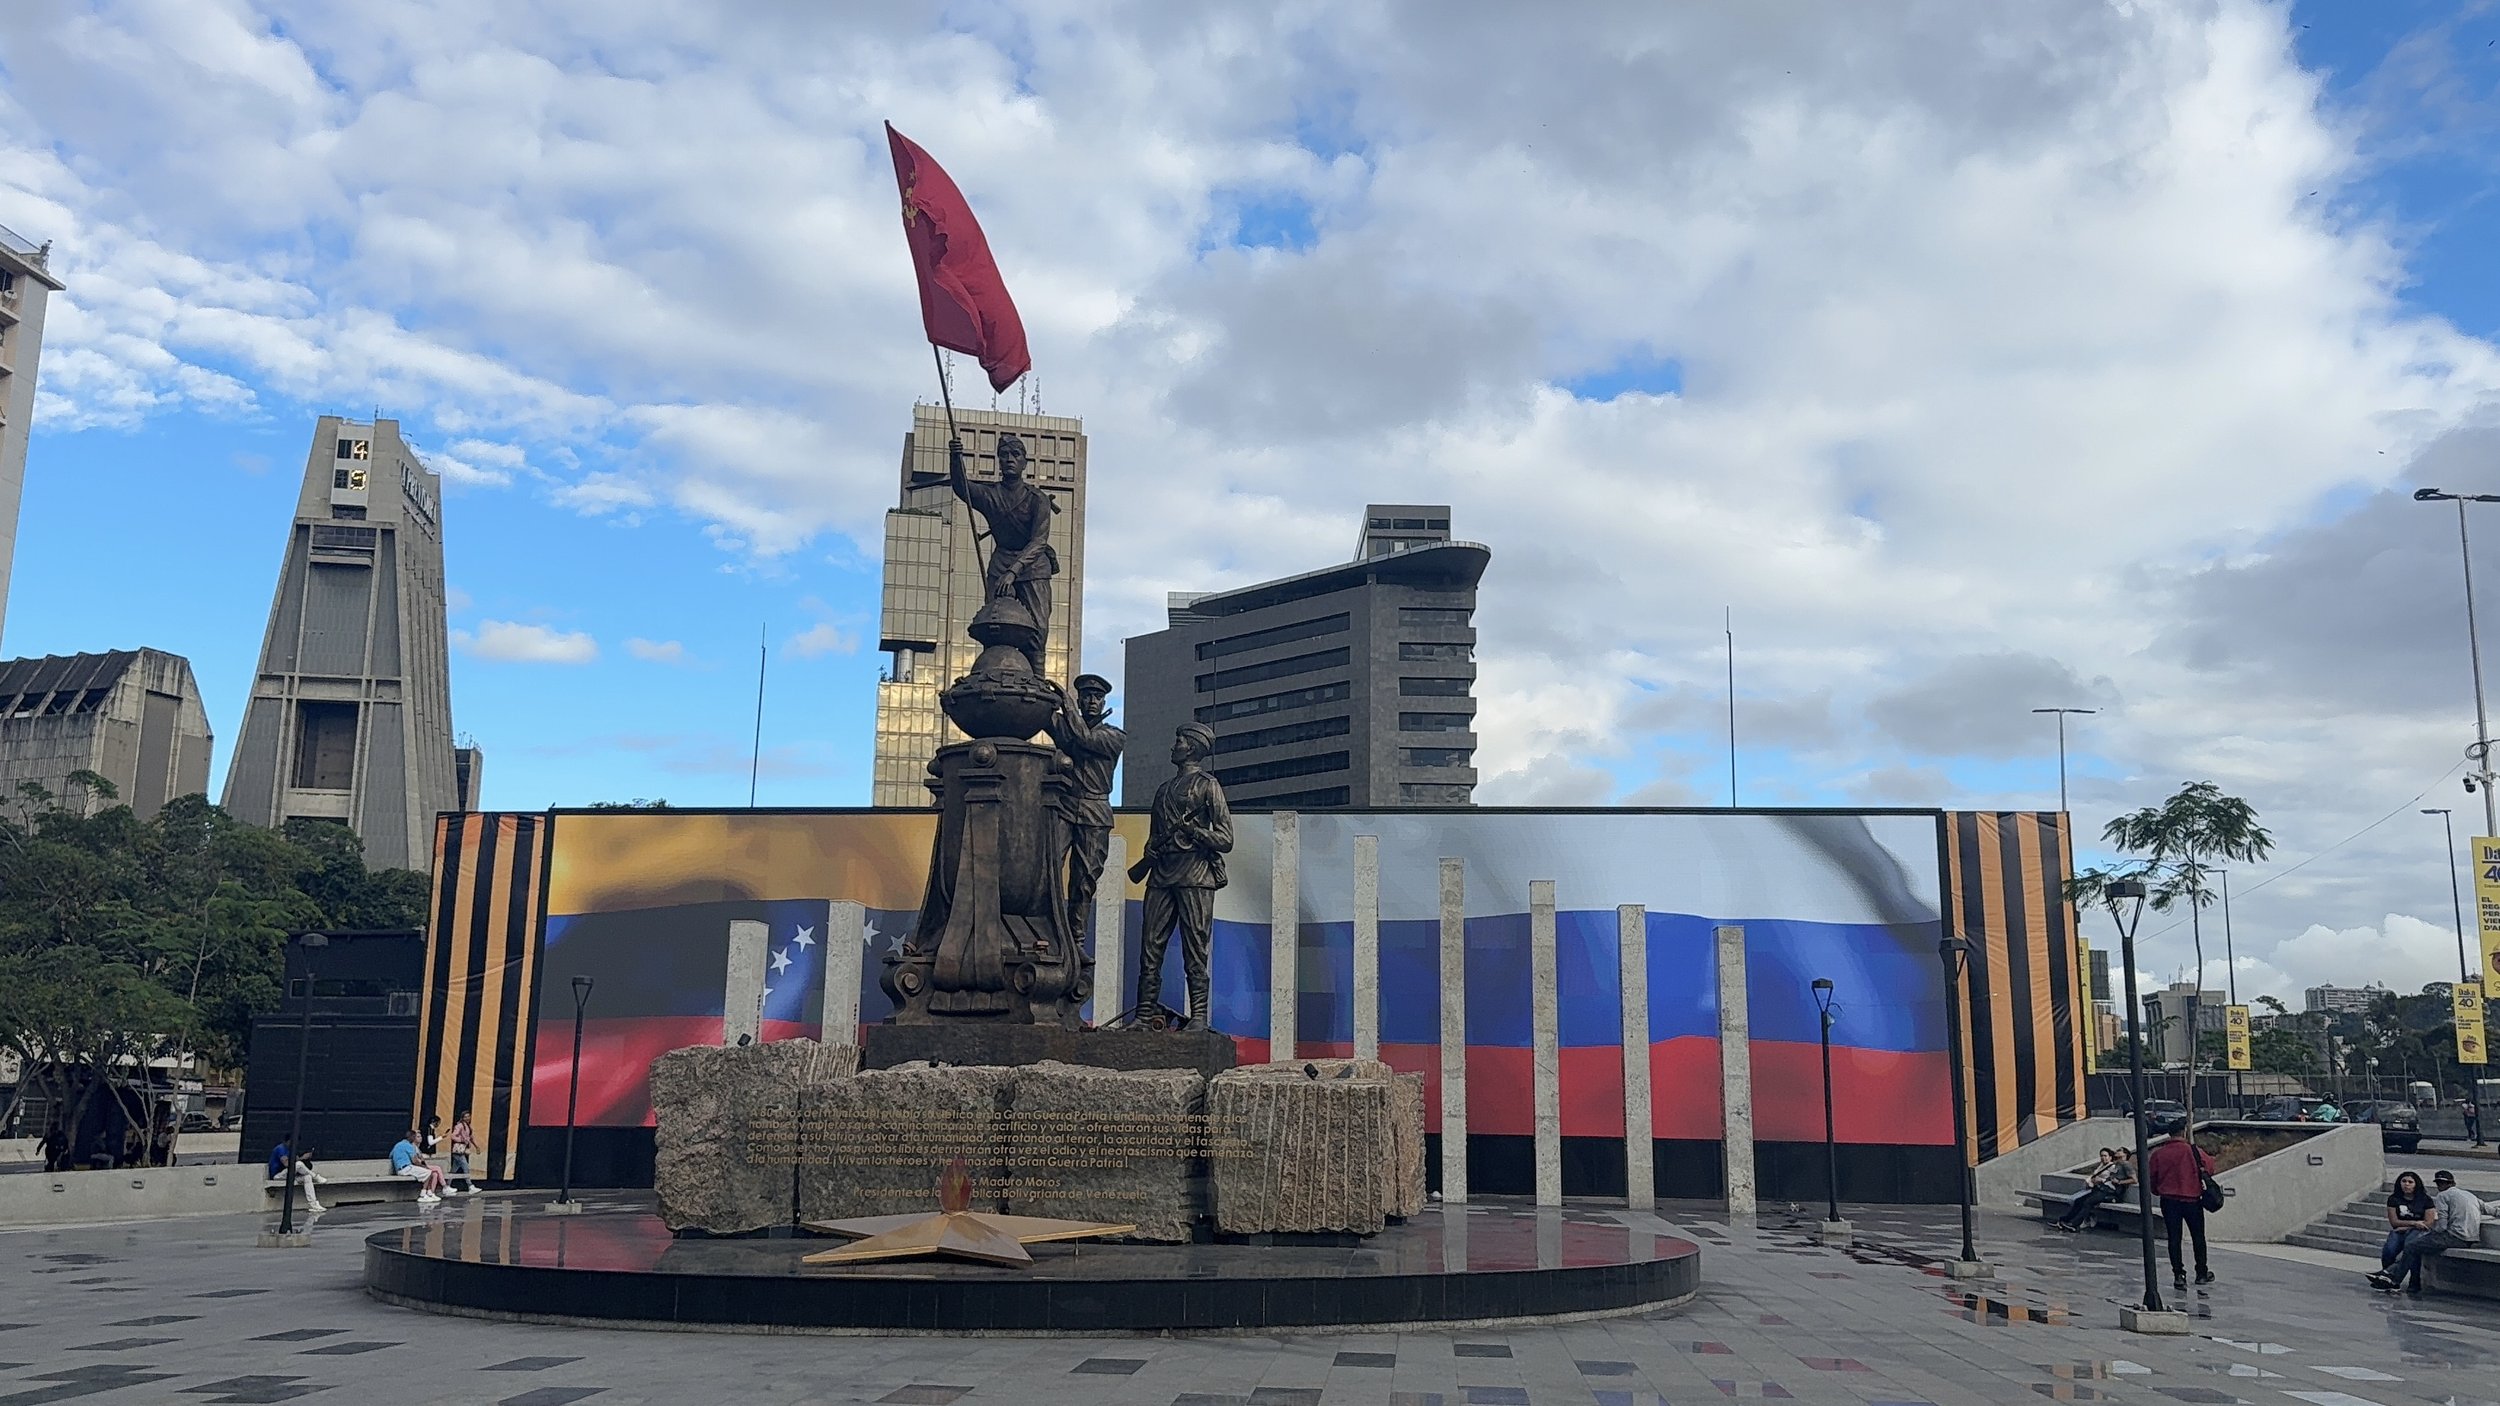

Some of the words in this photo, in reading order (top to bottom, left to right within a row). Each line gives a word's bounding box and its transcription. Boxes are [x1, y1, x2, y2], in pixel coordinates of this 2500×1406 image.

[353, 440, 368, 461] 4
[2458, 998, 2474, 1007] 40
[760, 1109, 773, 1117] 80
[804, 1109, 821, 1118] del
[992, 1110, 1002, 1120] la
[1003, 1110, 1031, 1120] Gran
[1033, 1111, 1072, 1121] Guerra
[1074, 1111, 1107, 1121] Patria
[1108, 1111, 1161, 1122] rendimos
[1163, 1112, 1220, 1125] homenaje
[1232, 1113, 1248, 1123] los
[748, 1120, 796, 1129] hombres
[807, 1121, 851, 1131] mujeres
[852, 1122, 876, 1131] que
[906, 1121, 986, 1132] incomparable
[986, 1121, 1038, 1131] sacrificio
[1040, 1124, 1047, 1133] y
[1049, 1122, 1078, 1132] valor
[1087, 1122, 1150, 1132] ofrendaron
[1152, 1125, 1170, 1133] sus
[1171, 1124, 1201, 1134] vidas
[1204, 1126, 1231, 1136] para
[747, 1131, 798, 1141] defender
[809, 1133, 822, 1141] su
[823, 1132, 855, 1141] Patria
[856, 1134, 864, 1144] y
[865, 1133, 899, 1142] salvar
[921, 1133, 987, 1144] humanidad,
[989, 1134, 1052, 1143] derrotando
[1054, 1134, 1065, 1144] al
[1066, 1134, 1102, 1145] terror,
[1103, 1135, 1114, 1144] la
[1115, 1135, 1173, 1145] oscuridad
[1175, 1138, 1182, 1147] y
[1184, 1136, 1195, 1146] el
[747, 1143, 781, 1152] Como
[814, 1143, 834, 1154] hoy
[853, 1143, 897, 1155] pueblos
[898, 1144, 929, 1154] libres
[930, 1143, 991, 1154] derrotarán
[993, 1145, 1016, 1154] otra
[1018, 1147, 1038, 1155] vez
[1040, 1146, 1051, 1155] el
[1051, 1146, 1077, 1155] odio
[1079, 1148, 1087, 1158] y
[1088, 1147, 1100, 1156] el
[1101, 1147, 1174, 1157] neofascismo
[1176, 1149, 1198, 1159] que
[1199, 1149, 1254, 1158] amenaza
[767, 1155, 832, 1165] humanidad.
[871, 1156, 888, 1165] los
[929, 1158, 938, 1168] y
[988, 1156, 1004, 1166] de
[1005, 1157, 1016, 1166] la
[1017, 1157, 1046, 1167] Gran
[1047, 1157, 1089, 1167] Guerra
[978, 1177, 1022, 1187] Maduro
[1024, 1177, 1061, 1187] Moros
[853, 1187, 913, 1197] Presidente
[915, 1187, 930, 1198] de
[931, 1187, 942, 1198] la
[1002, 1188, 1066, 1199] Bolivariana
[1068, 1189, 1083, 1199] de
[1085, 1188, 1148, 1200] Venezuela
